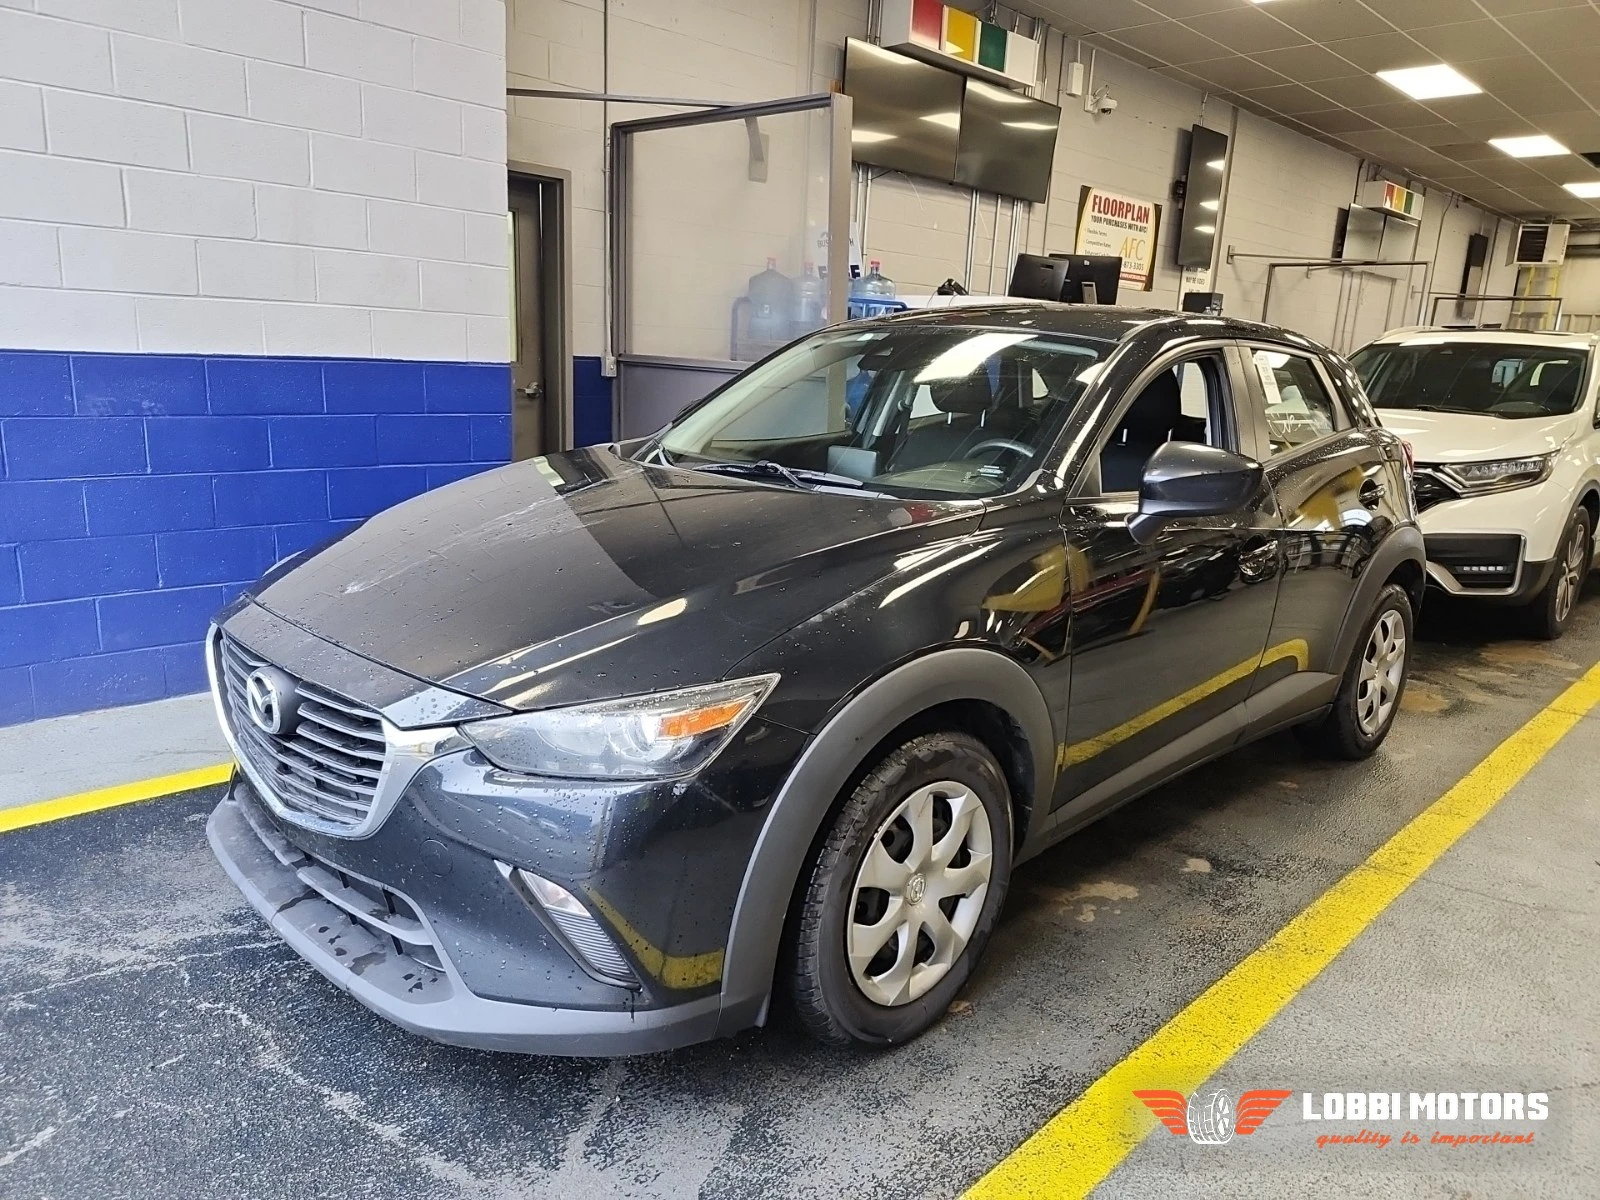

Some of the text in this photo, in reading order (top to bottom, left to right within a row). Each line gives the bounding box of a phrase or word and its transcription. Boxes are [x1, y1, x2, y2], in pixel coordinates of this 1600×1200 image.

[1092, 194, 1150, 224] FLOORPLAN
[1091, 215, 1103, 224] YOUR
[1103, 217, 1128, 229] PURCHASES
[1127, 223, 1139, 231] WITH
[1119, 236, 1146, 261] AFC
